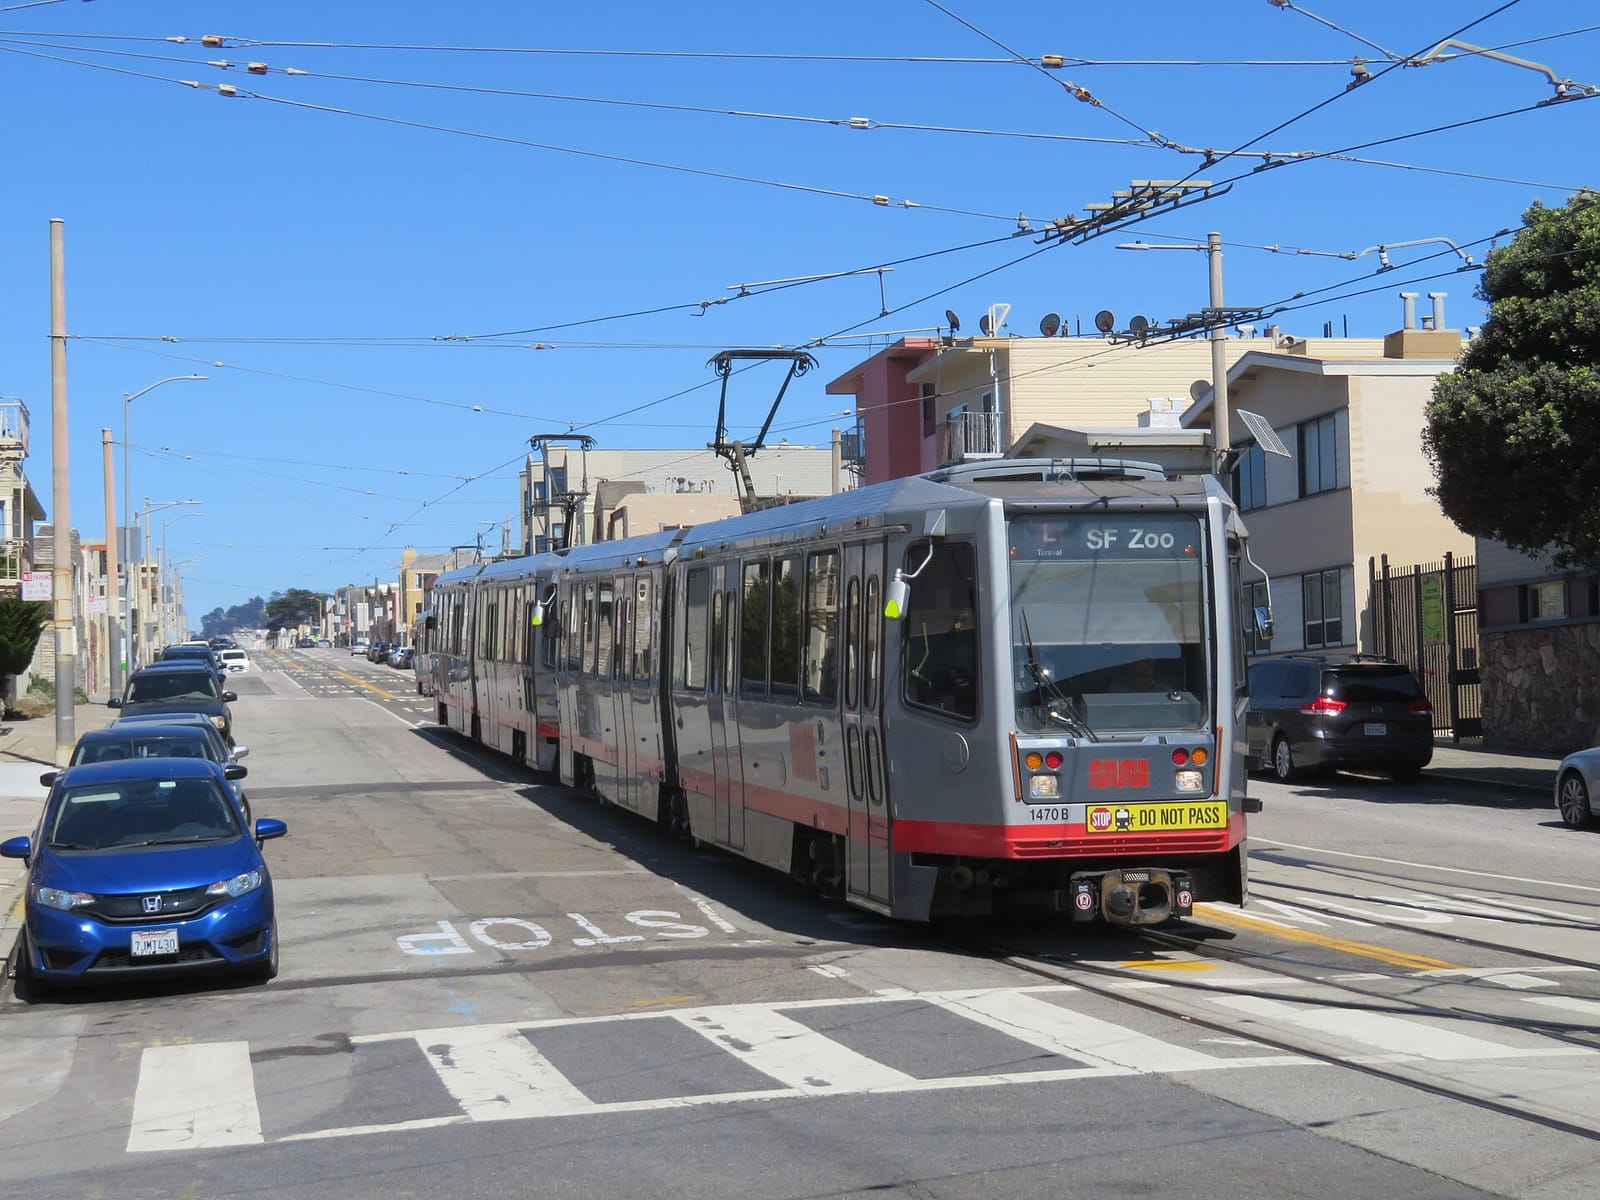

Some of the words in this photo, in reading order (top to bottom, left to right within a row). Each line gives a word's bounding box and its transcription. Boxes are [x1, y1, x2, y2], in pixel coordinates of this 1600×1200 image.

[1043, 523, 1056, 542] L
[1086, 528, 1118, 549] SF
[1128, 528, 1175, 549] Zoo
[1091, 811, 1111, 827] STOP
[1139, 809, 1156, 826] DO
[1160, 808, 1185, 825] NOT
[1189, 807, 1220, 824] PASS
[396, 909, 710, 956] STOP
